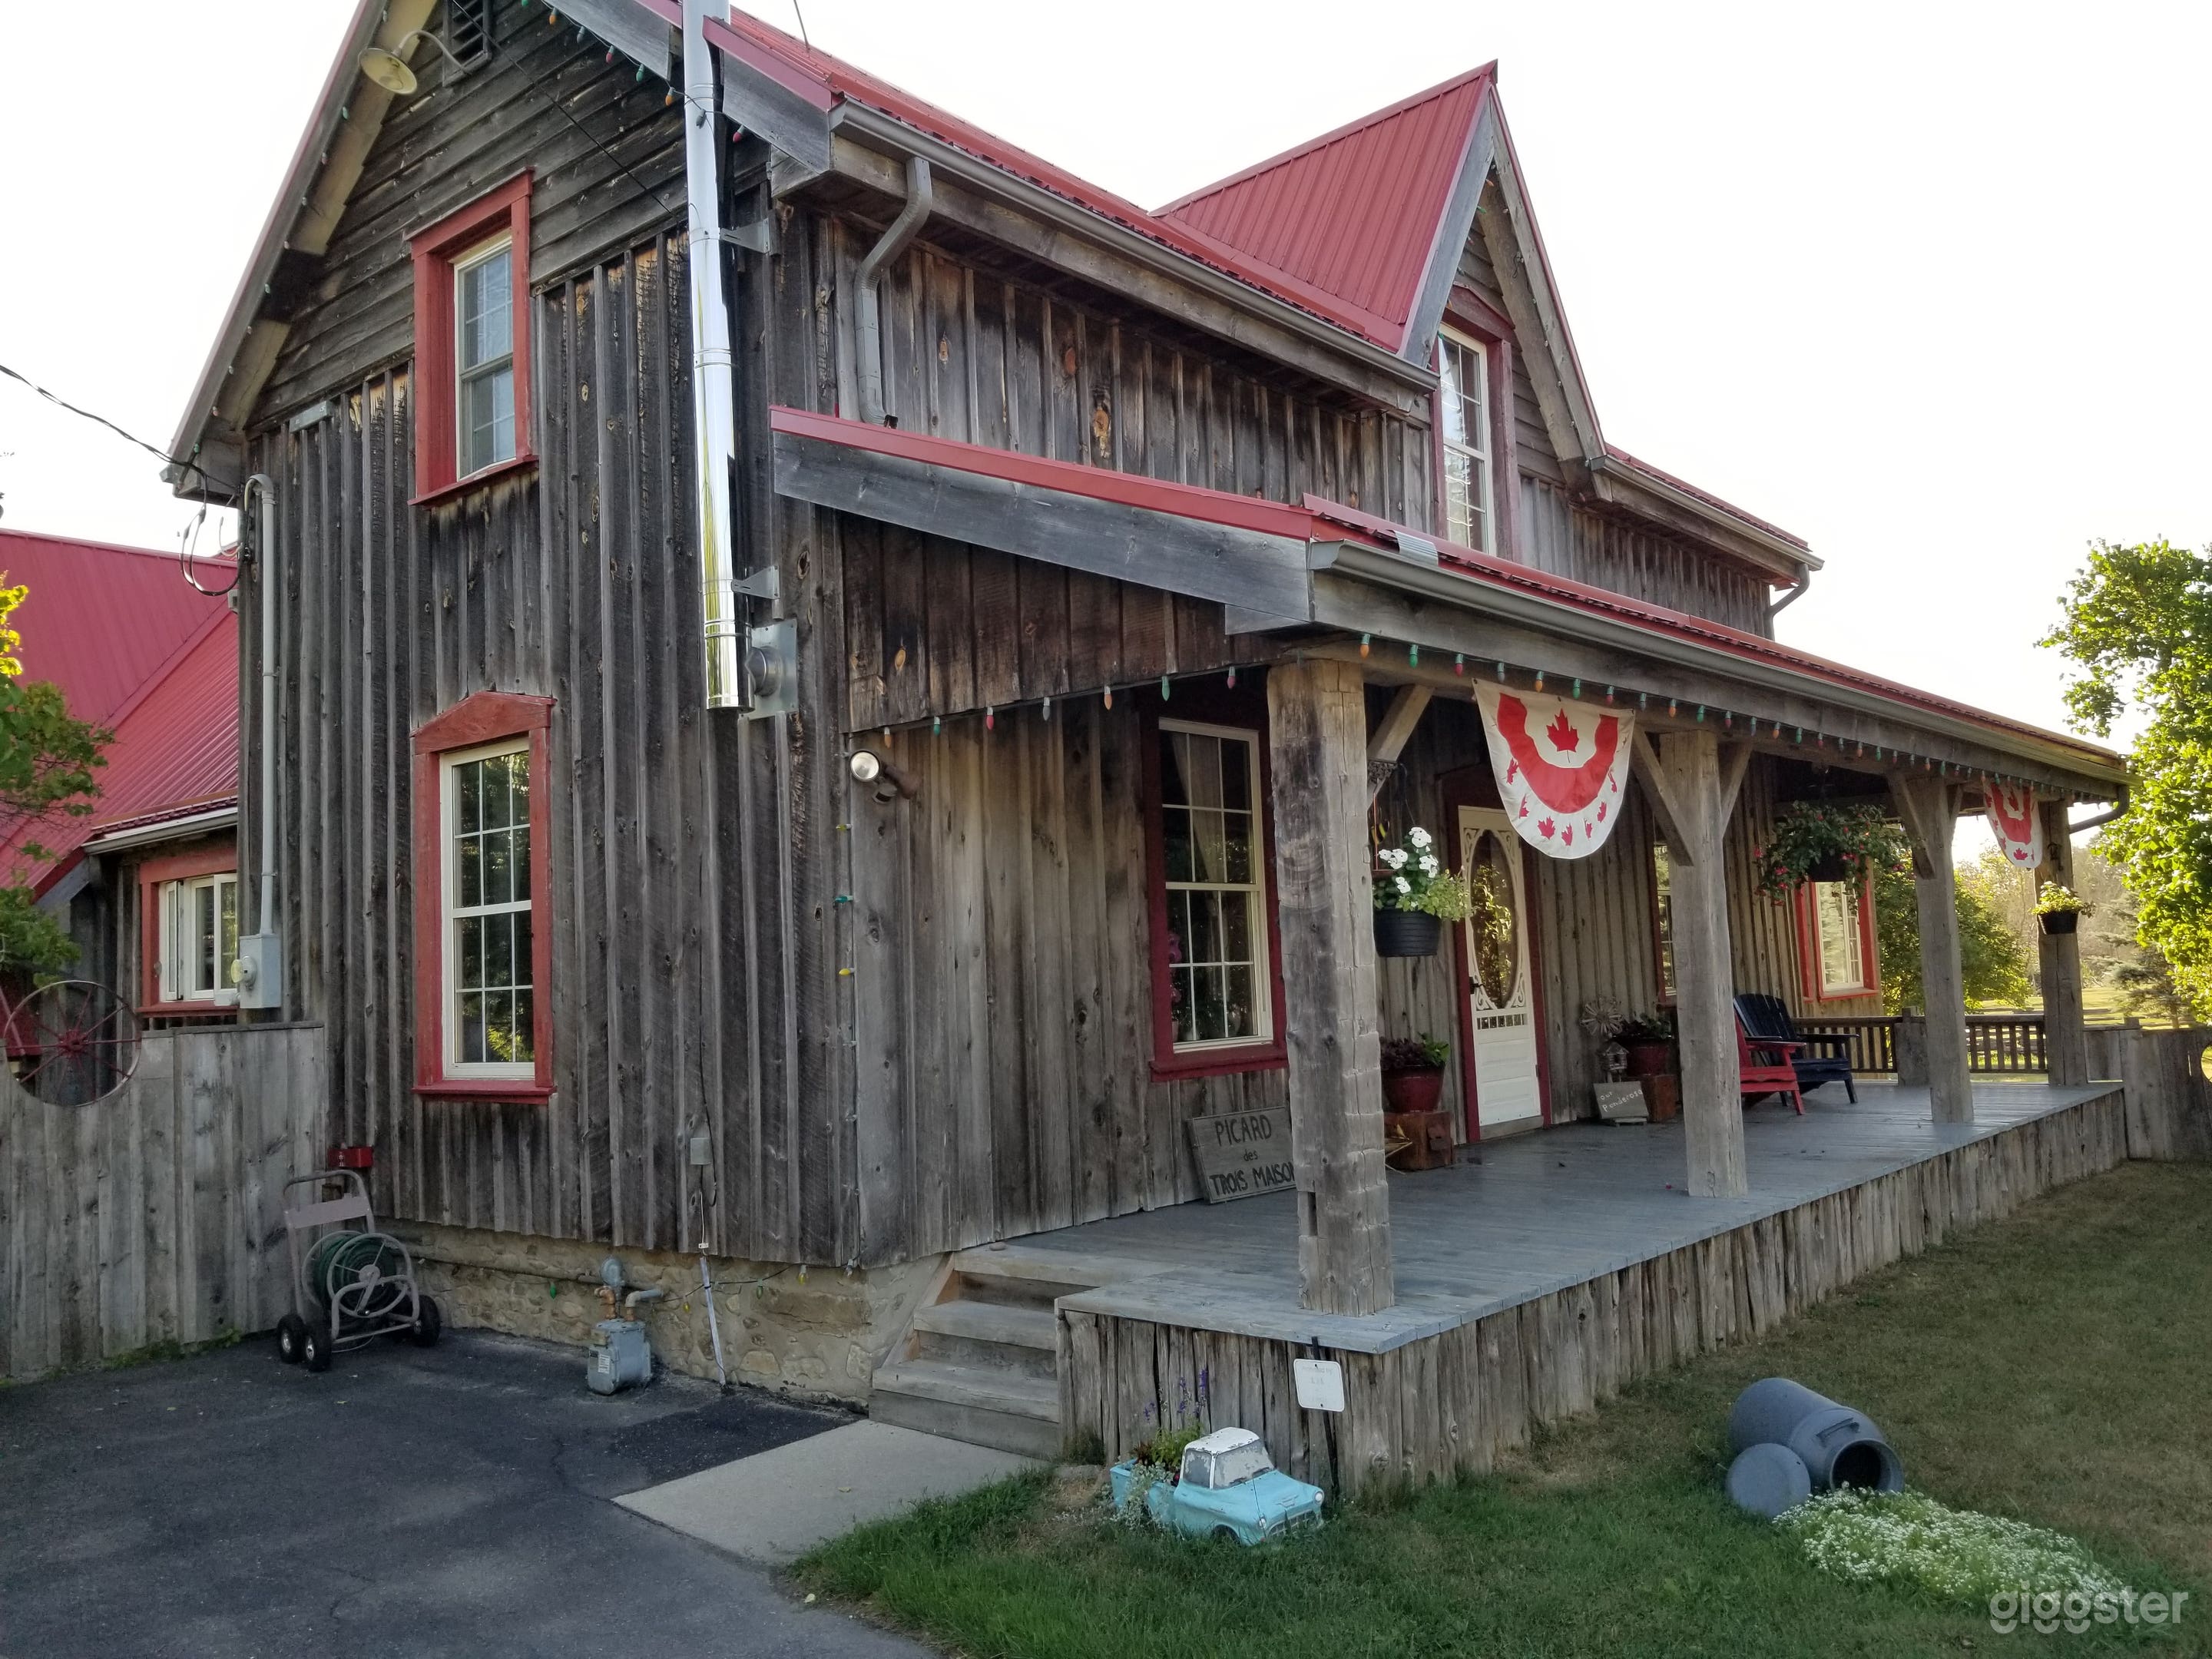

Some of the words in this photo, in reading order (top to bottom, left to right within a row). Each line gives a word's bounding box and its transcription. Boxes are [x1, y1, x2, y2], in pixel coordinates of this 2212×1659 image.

[1214, 1114, 1272, 1147] PICARD
[1243, 1148, 1259, 1161] des
[1209, 1169, 1248, 1196] TROIS
